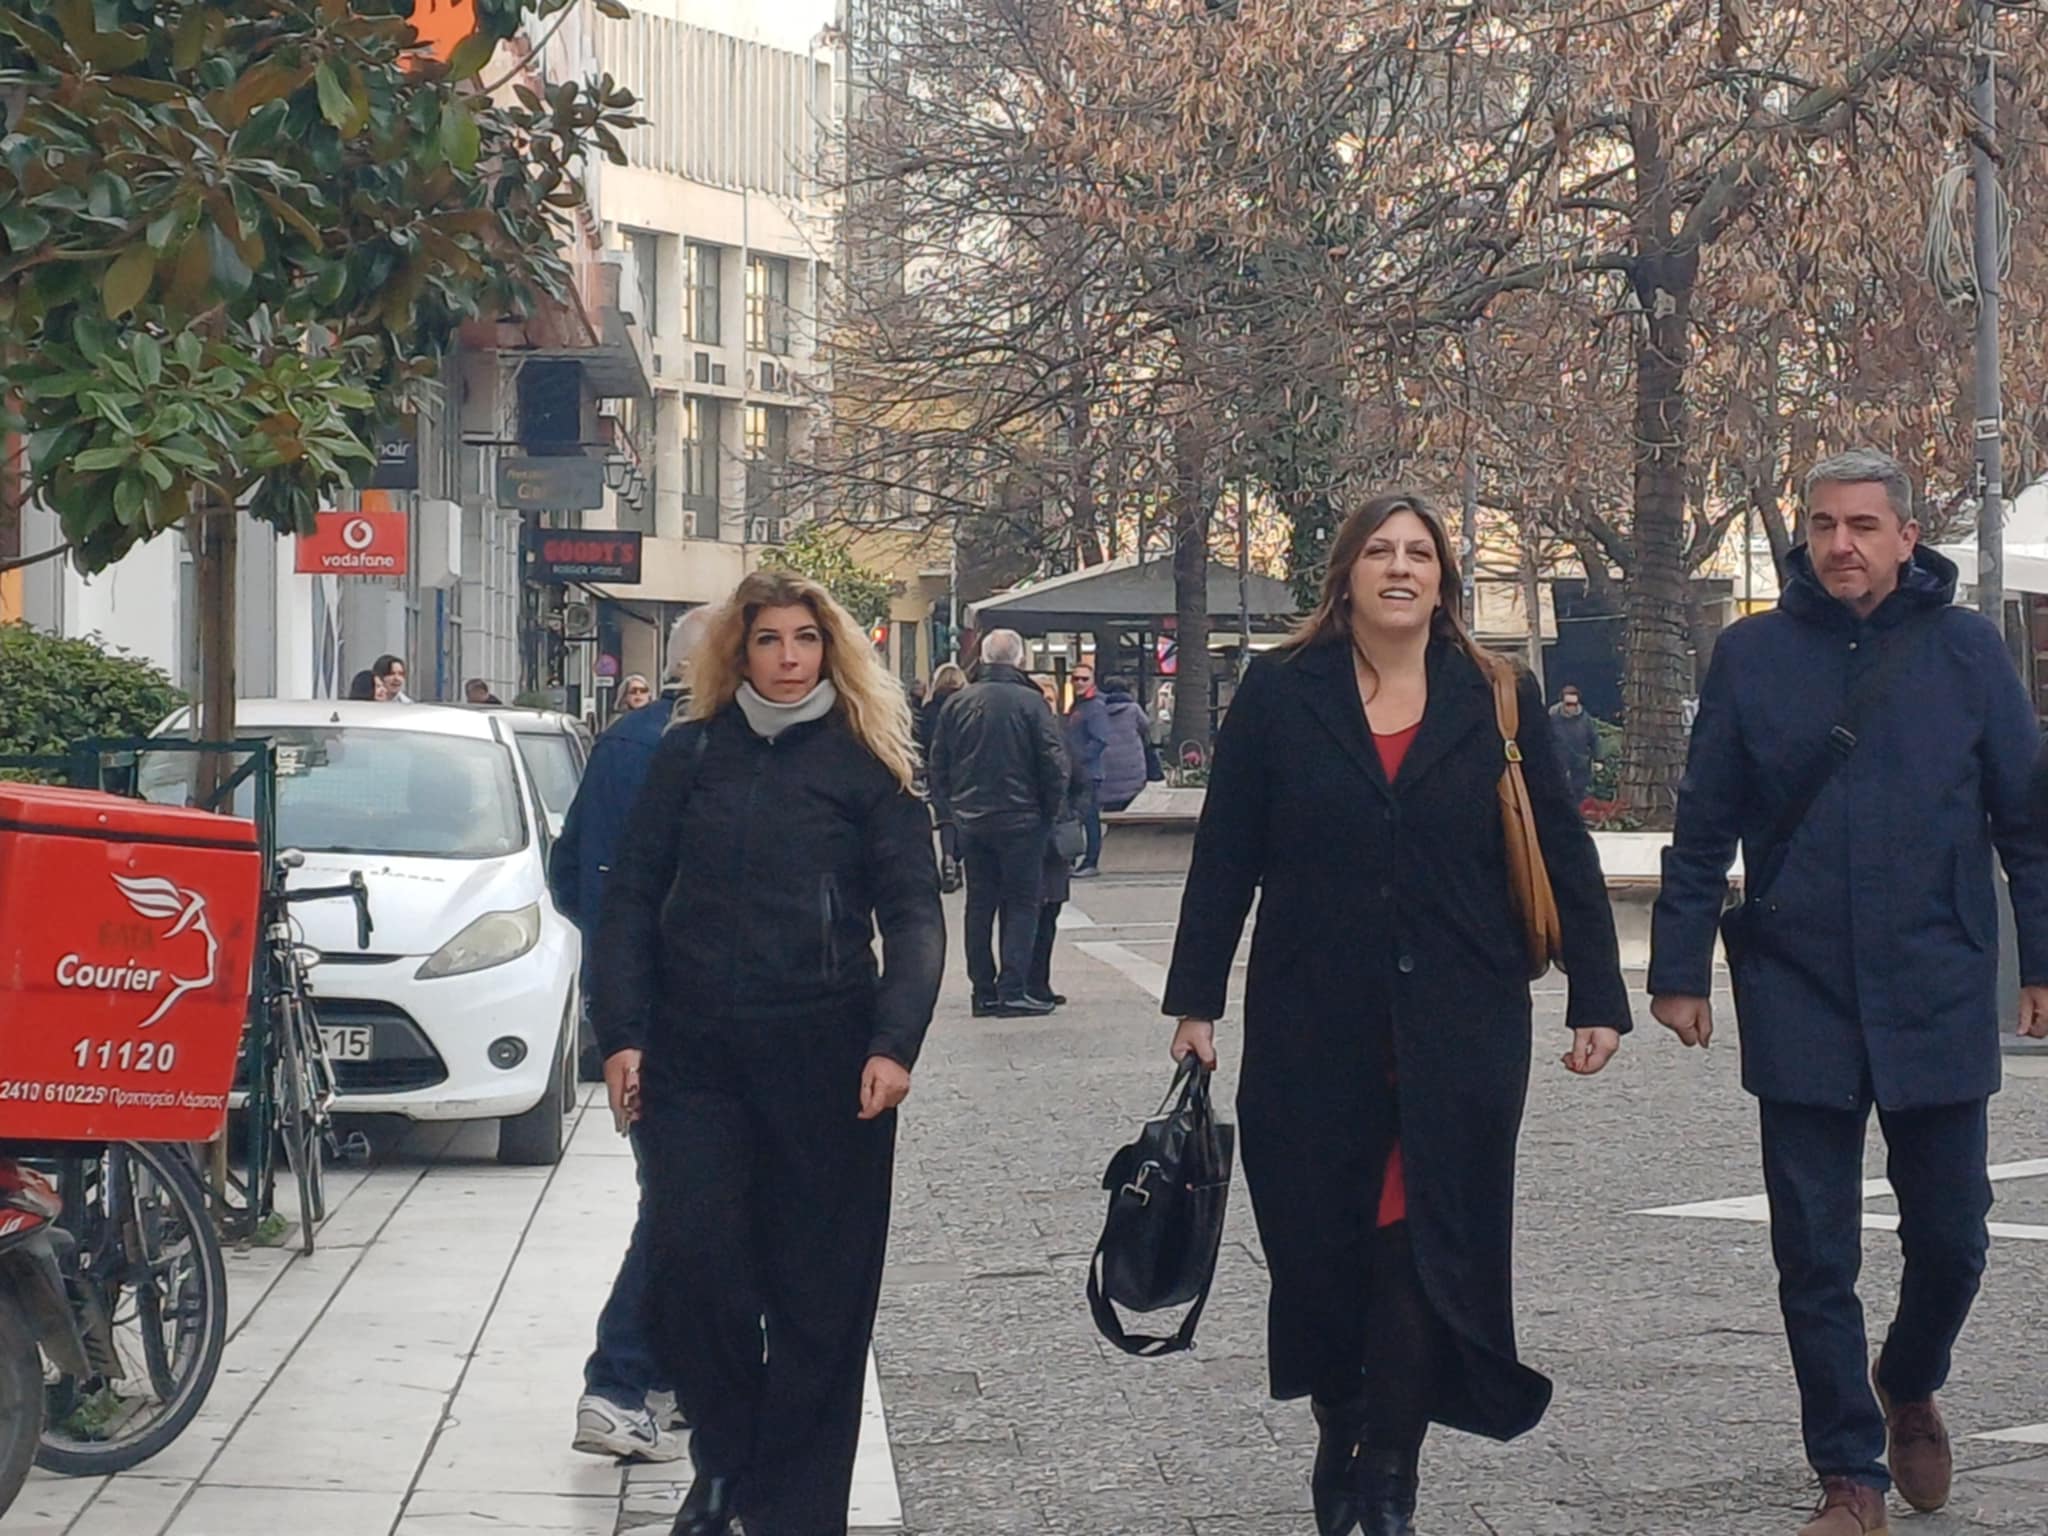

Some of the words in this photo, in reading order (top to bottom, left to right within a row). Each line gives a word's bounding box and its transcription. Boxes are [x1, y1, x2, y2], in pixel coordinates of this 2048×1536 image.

[321, 553, 394, 567] vodafone
[56, 953, 162, 991] Courier
[73, 1038, 175, 1072] 11120
[0, 1081, 41, 1102] 2410
[44, 1084, 108, 1104] 610225
